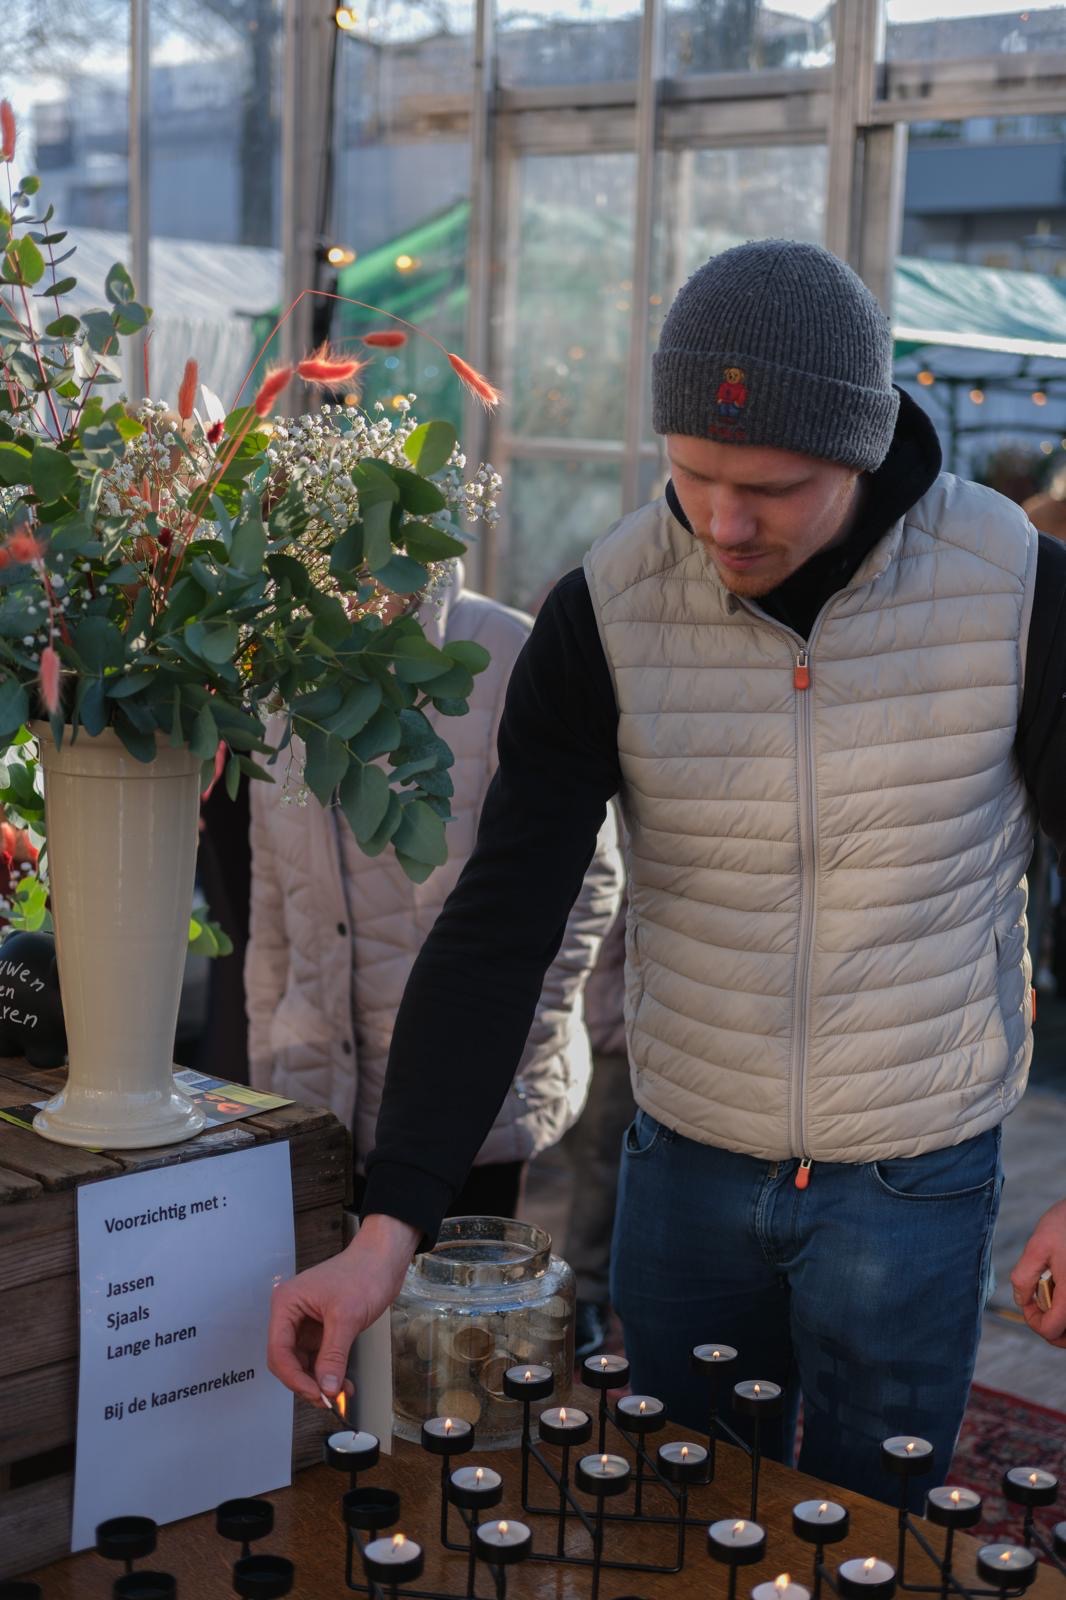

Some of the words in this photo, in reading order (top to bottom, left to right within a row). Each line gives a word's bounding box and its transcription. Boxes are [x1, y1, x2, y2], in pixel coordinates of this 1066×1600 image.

[0, 1005, 38, 1028] ren
[104, 1203, 187, 1234] Voorzichtig
[190, 1196, 219, 1215] met
[106, 1275, 155, 1298] Jassen
[107, 1305, 150, 1331] Sjaals
[107, 1339, 151, 1361] Lange
[155, 1326, 197, 1348] haren
[104, 1402, 124, 1421] Bij
[128, 1397, 147, 1415] de
[151, 1368, 255, 1409] kaarsenrekken
